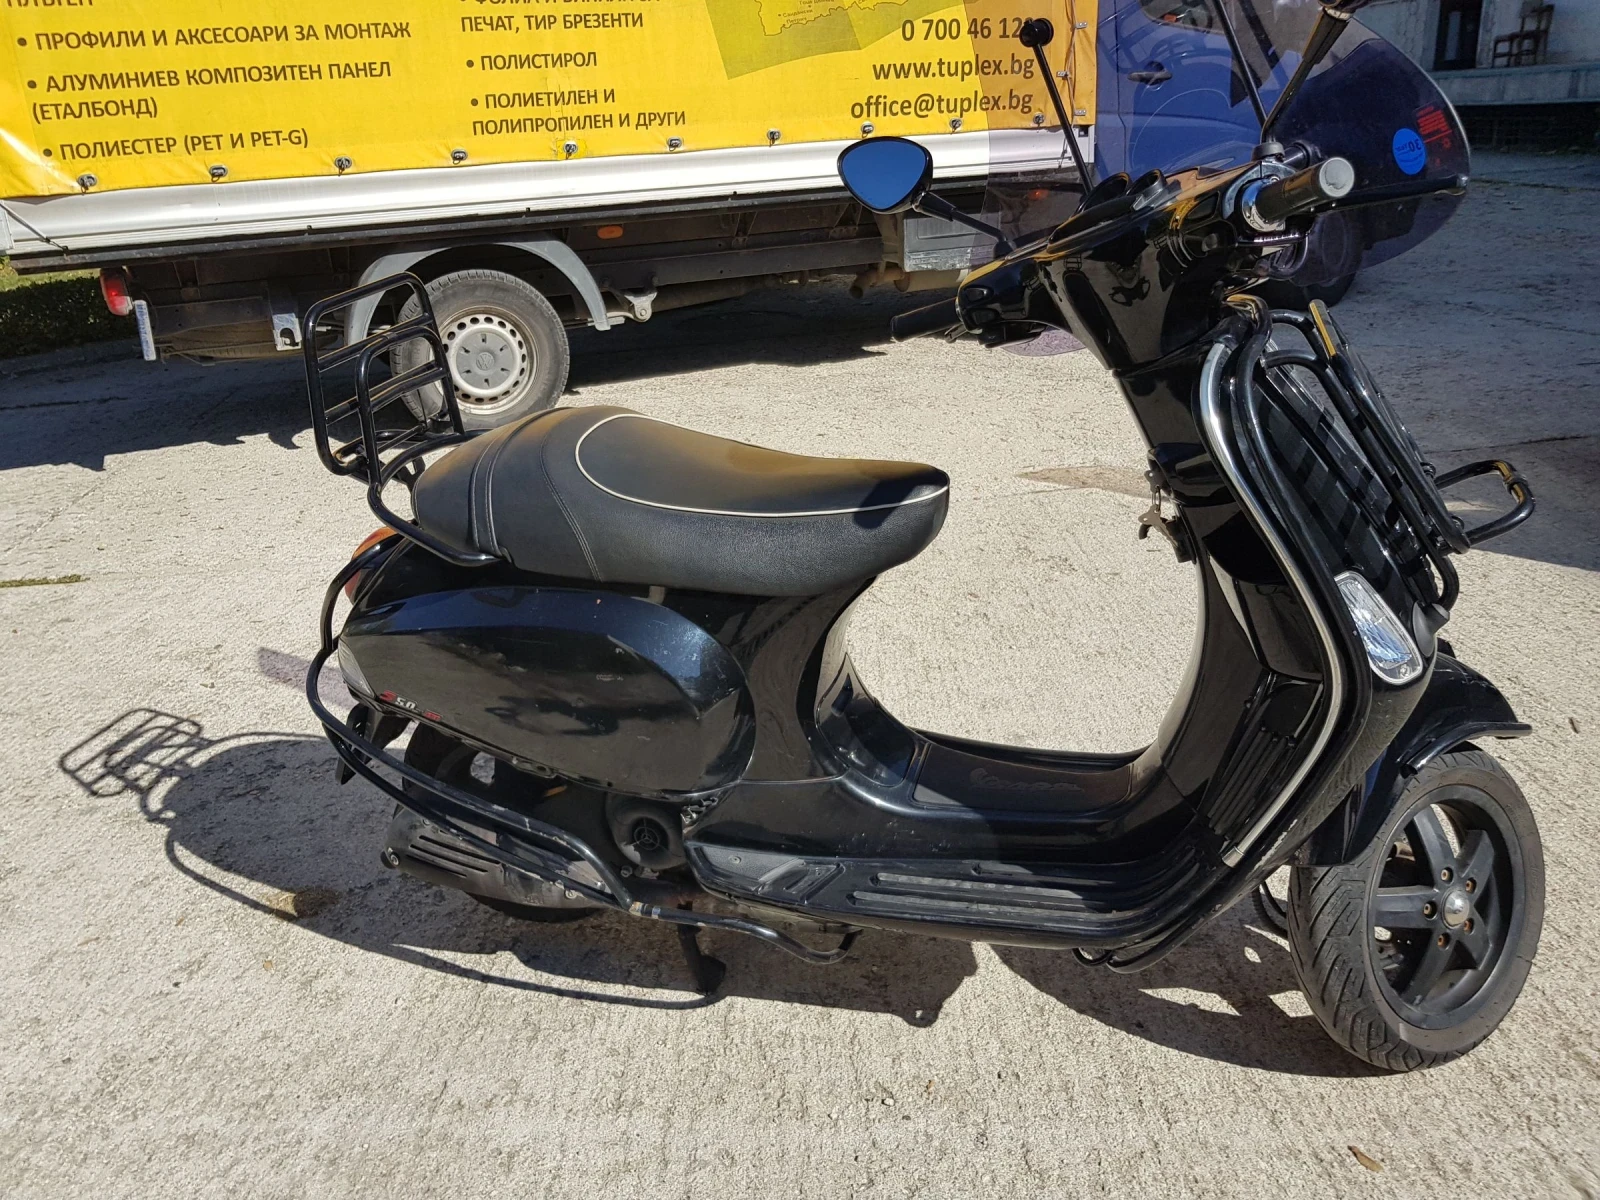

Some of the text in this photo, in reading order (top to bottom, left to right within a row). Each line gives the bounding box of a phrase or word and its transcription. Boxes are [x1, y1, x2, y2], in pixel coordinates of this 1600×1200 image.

[35, 21, 413, 51] ПРОФИЛИ И АКСЕСОАРИ ЗА МОНТАЖ
[461, 12, 644, 34] ПЕЧАТ, ТИР БРЕЗЕНТИ
[901, 19, 915, 42] 0
[921, 18, 961, 41] 700
[967, 17, 992, 39] 46
[480, 51, 598, 71] ПОЛИСТИРОЛ
[872, 53, 1035, 81] www.tuplex.bg
[46, 61, 392, 93] АЛУМИНИЕВ КОМПОЗИТЕН ПАНЕЛ
[31, 96, 159, 125] (ЕТАЛБОНД)
[485, 88, 616, 109] ПОЛИЕТИЛЕН И
[850, 89, 1034, 119] office@tuplex.bg
[472, 110, 686, 136] ПОЛИПРОПИЛЕН И ДРУГИ
[60, 136, 178, 161] ПОЛИЕСТЕР
[229, 133, 245, 150] И
